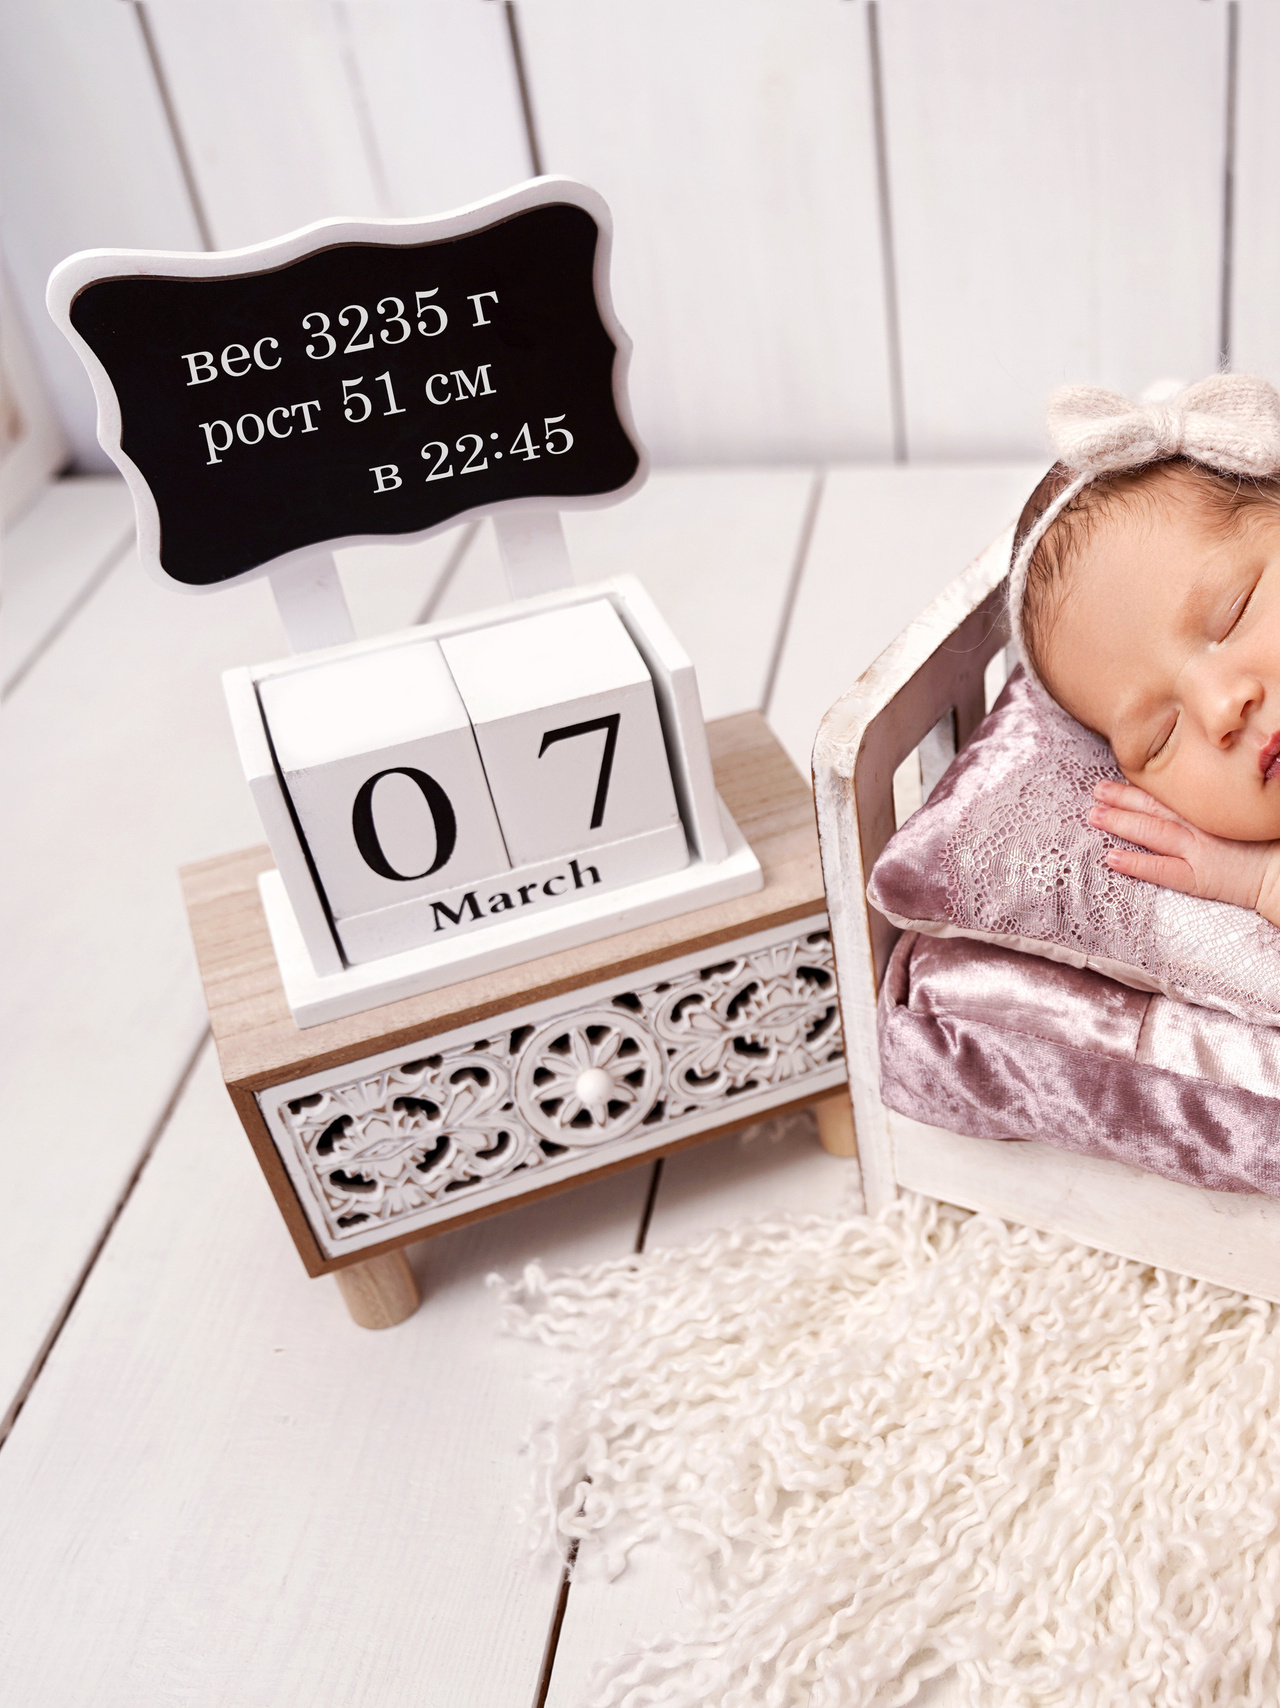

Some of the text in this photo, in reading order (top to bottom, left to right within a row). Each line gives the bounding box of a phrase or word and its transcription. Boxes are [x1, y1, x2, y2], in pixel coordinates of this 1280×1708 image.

[181, 286, 499, 387] вес 3235 г
[198, 363, 497, 466] рост 51 см
[369, 413, 575, 494] в 22:45
[428, 858, 603, 933] March
